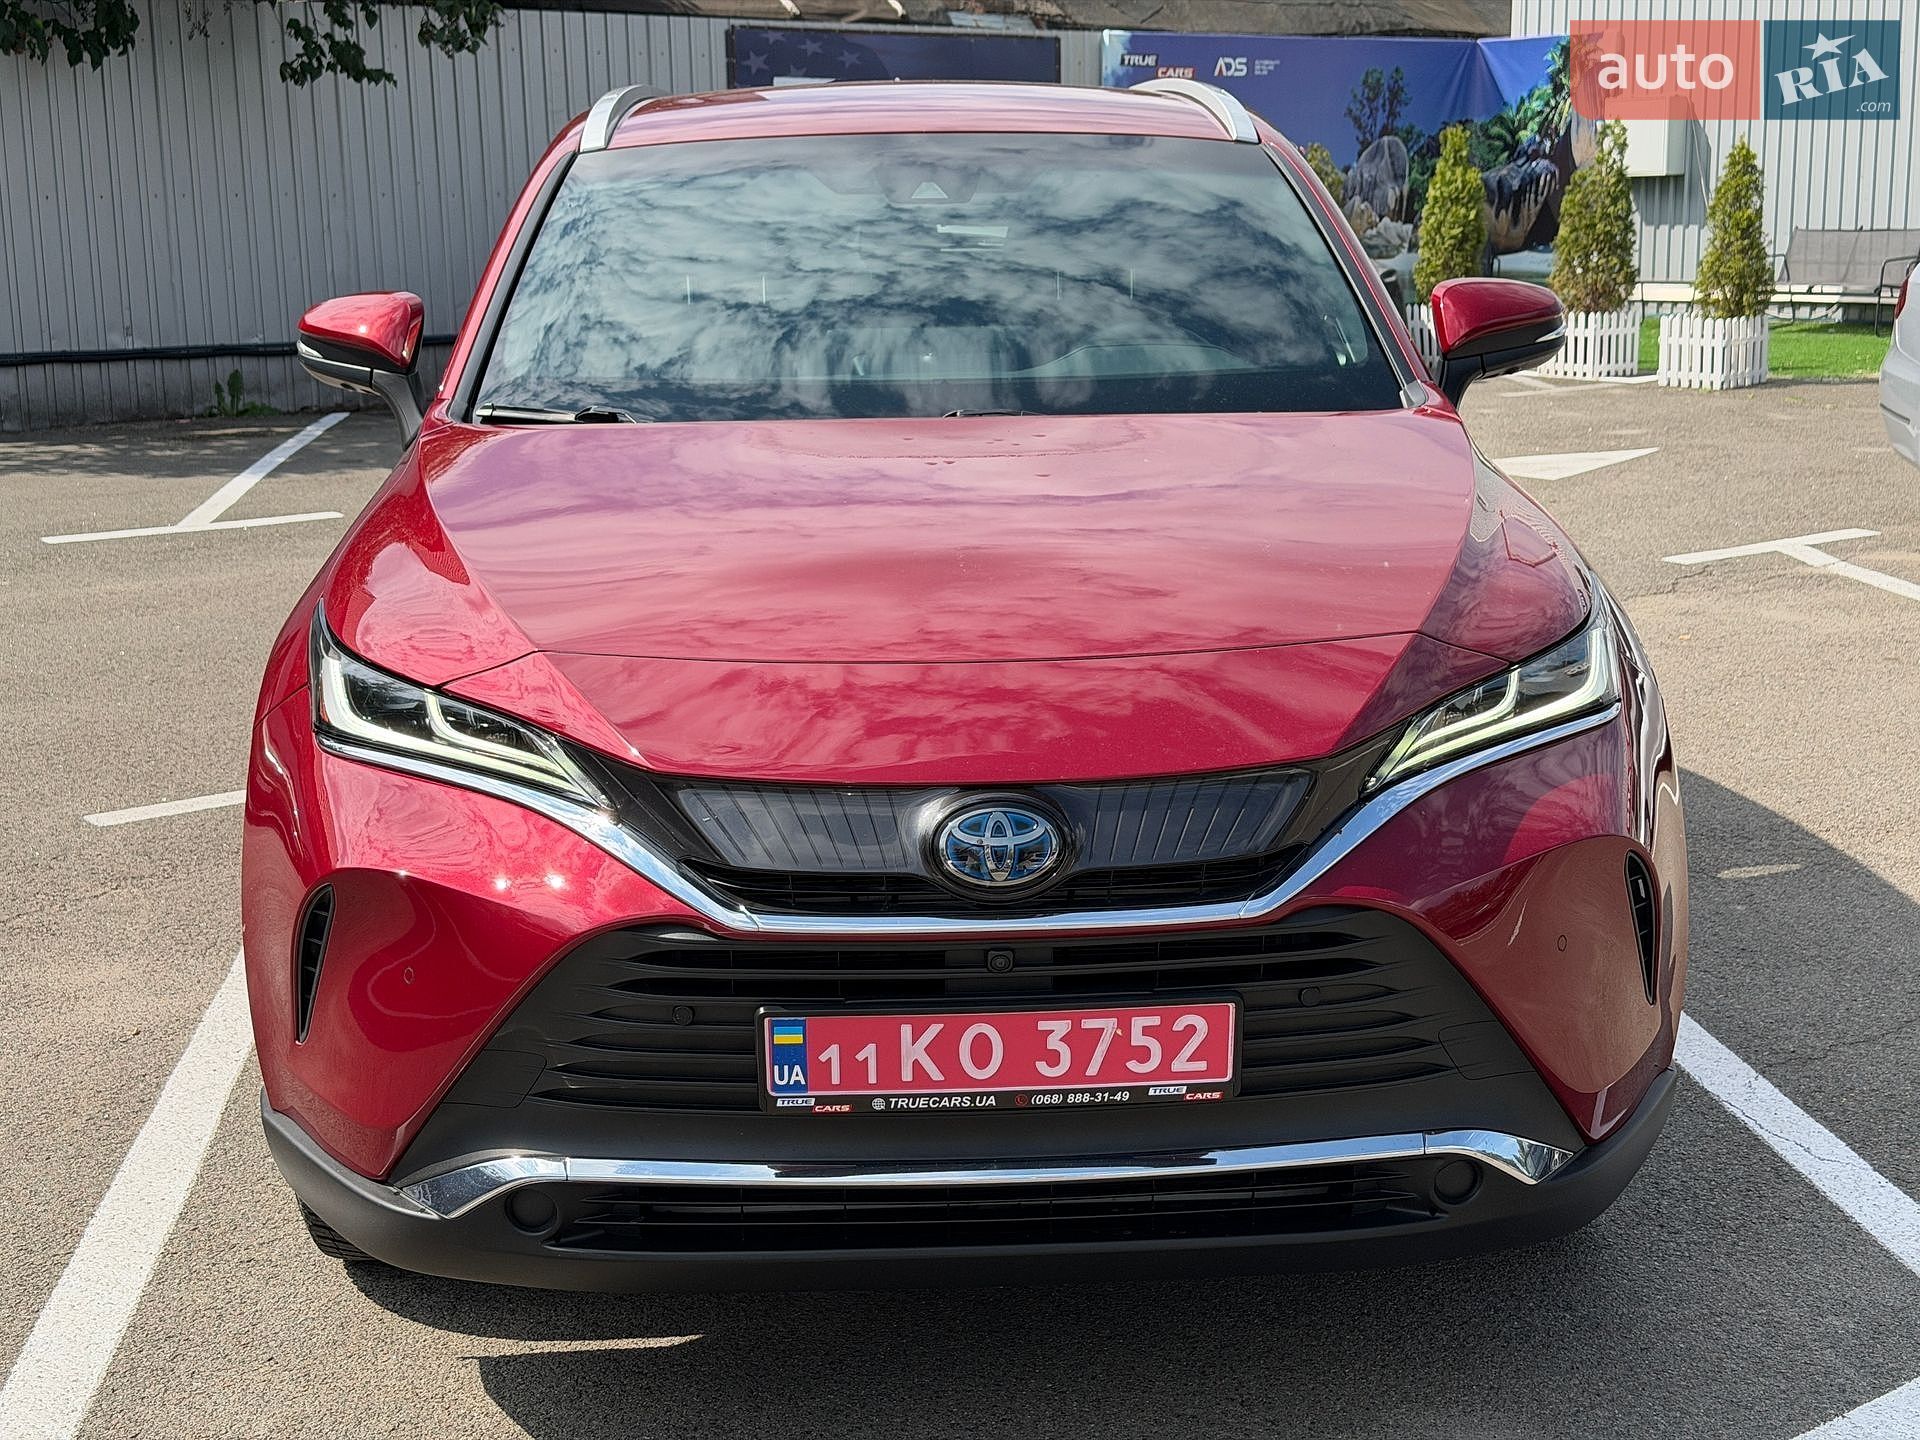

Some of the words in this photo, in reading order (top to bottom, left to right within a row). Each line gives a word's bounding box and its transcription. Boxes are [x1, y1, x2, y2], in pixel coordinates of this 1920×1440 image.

[1123, 55, 1157, 66] TRUE
[1214, 56, 1248, 77] ADS
[1157, 66, 1194, 78] CARS
[817, 1043, 877, 1085] 11
[900, 1022, 1004, 1082] KO
[1035, 1014, 1209, 1078] 3752
[773, 1064, 807, 1085] UA
[1150, 1085, 1186, 1095] TRUE
[1184, 1091, 1222, 1100] CARS
[778, 1097, 815, 1106] TRUE
[889, 1095, 997, 1109] TRUECARS.UA
[1031, 1093, 1064, 1105] (068)
[1067, 1091, 1130, 1104] 888-31-49
[813, 1104, 851, 1112] CARS
